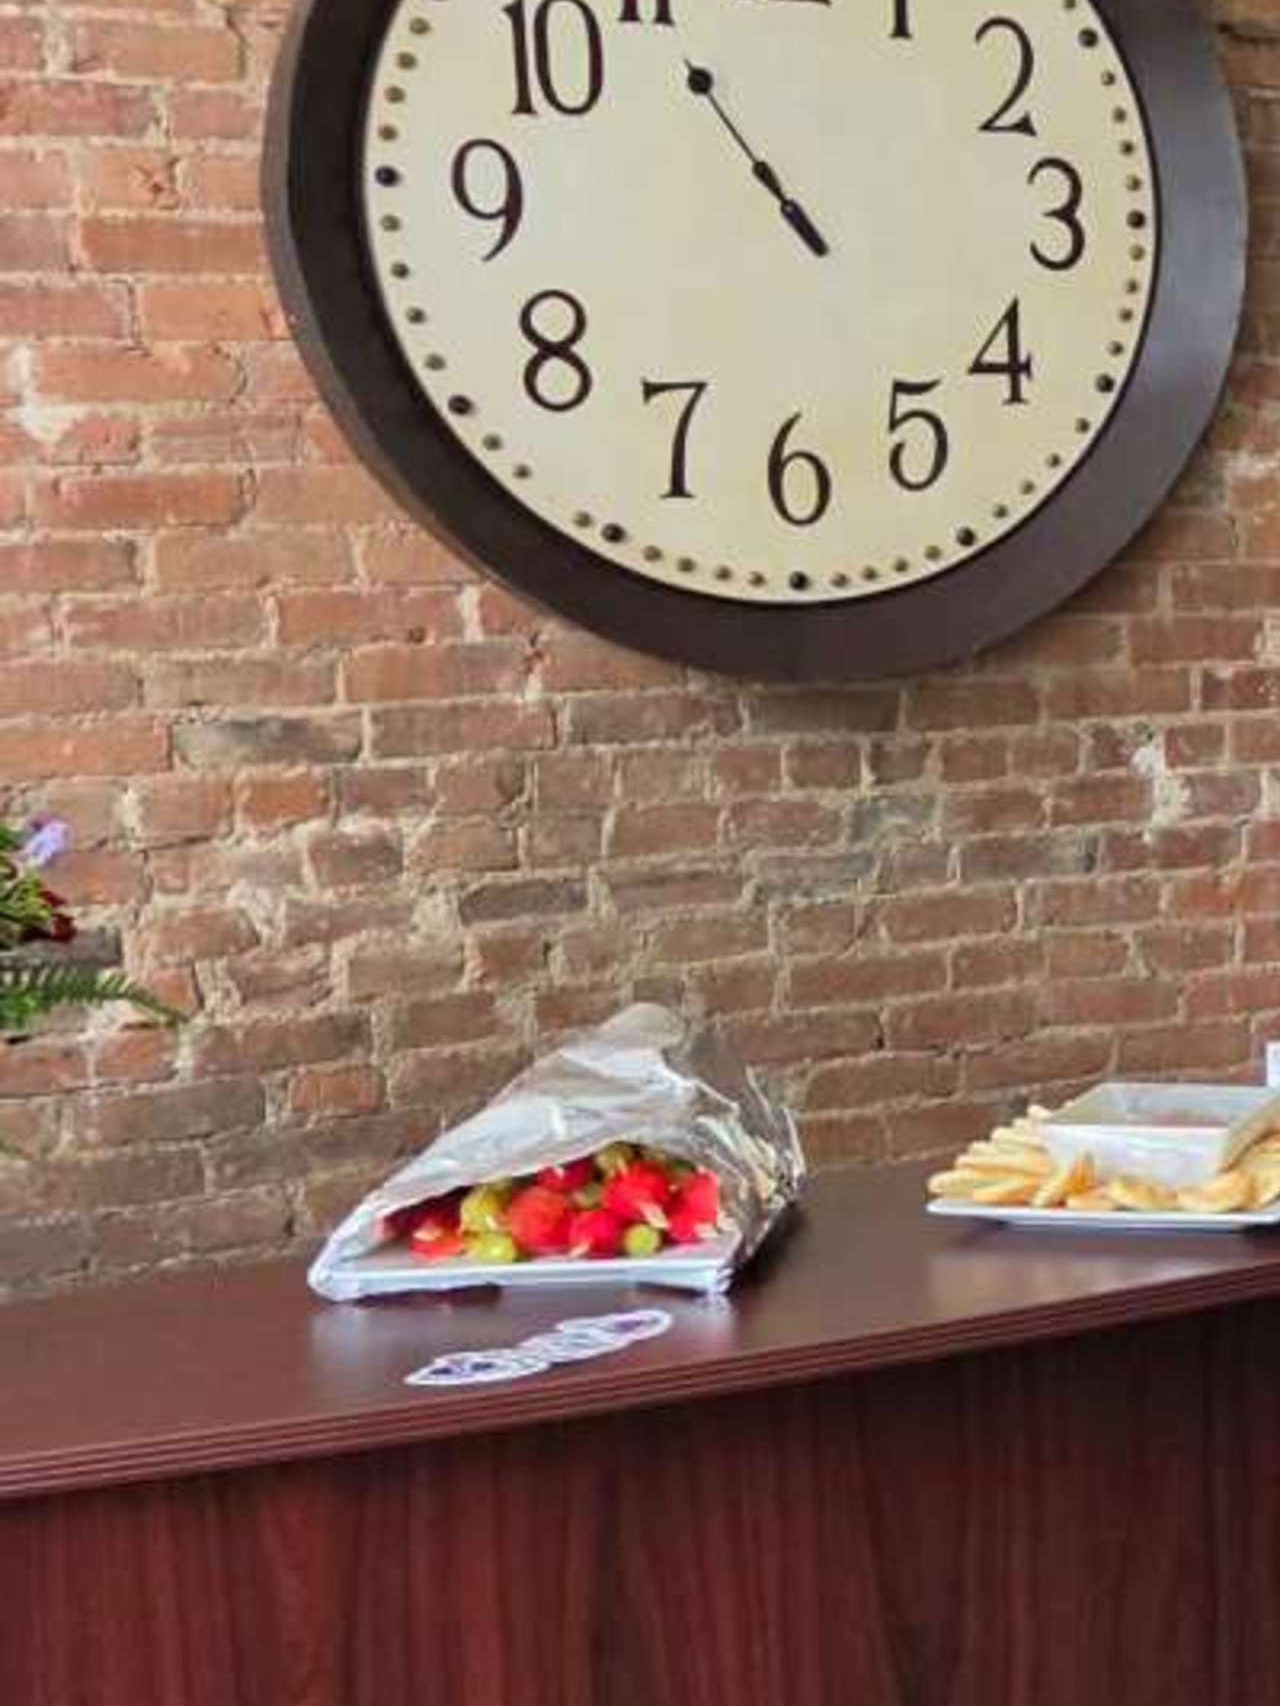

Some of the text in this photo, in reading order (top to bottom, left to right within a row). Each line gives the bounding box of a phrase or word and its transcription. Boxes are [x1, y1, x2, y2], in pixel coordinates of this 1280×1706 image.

[974, 16, 1037, 137] 2
[451, 138, 524, 262] 9
[1026, 157, 1086, 271] 3
[518, 289, 593, 413] 8
[966, 297, 1033, 406] 4
[640, 379, 708, 499] 7
[767, 412, 832, 527] 6
[887, 378, 949, 492] 5
